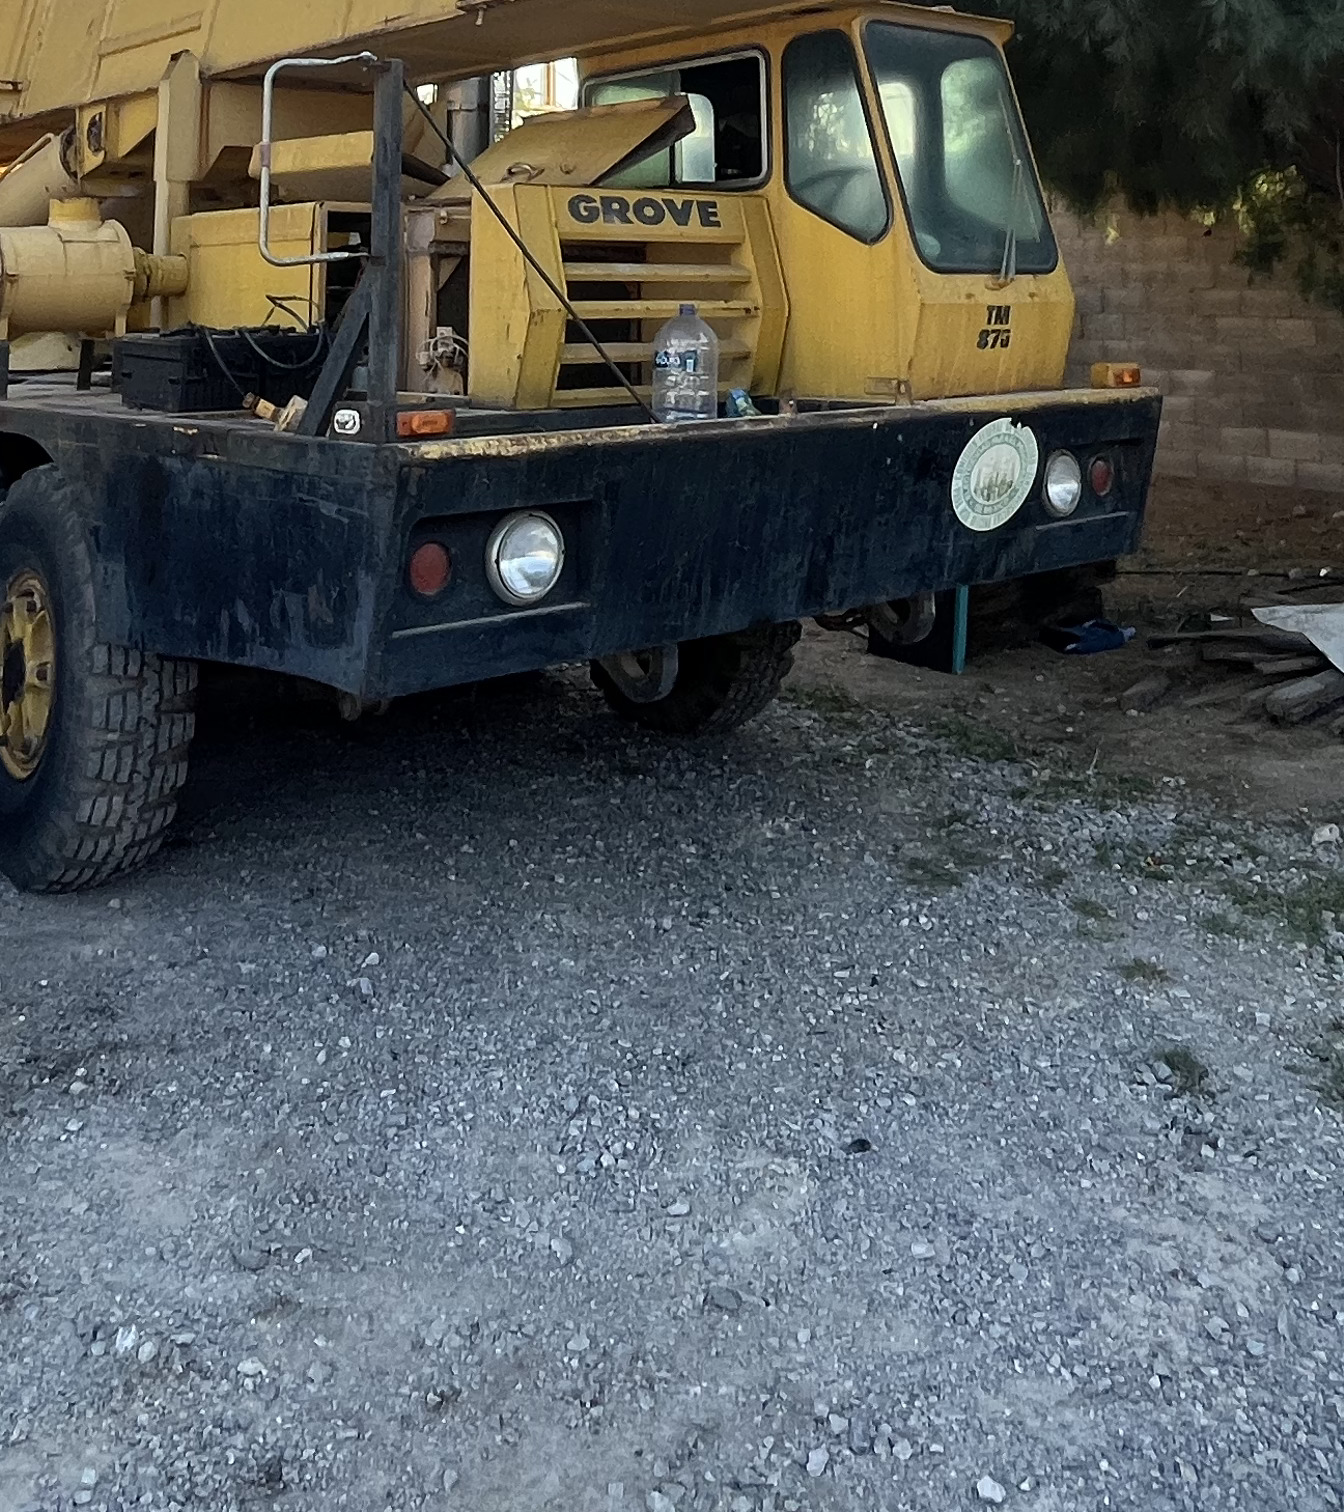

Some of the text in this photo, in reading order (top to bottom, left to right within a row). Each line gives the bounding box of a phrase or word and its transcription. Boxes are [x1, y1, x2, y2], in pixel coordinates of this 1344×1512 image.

[567, 193, 723, 228] GROVE
[986, 304, 1012, 326] TM
[976, 329, 1012, 350] 875
